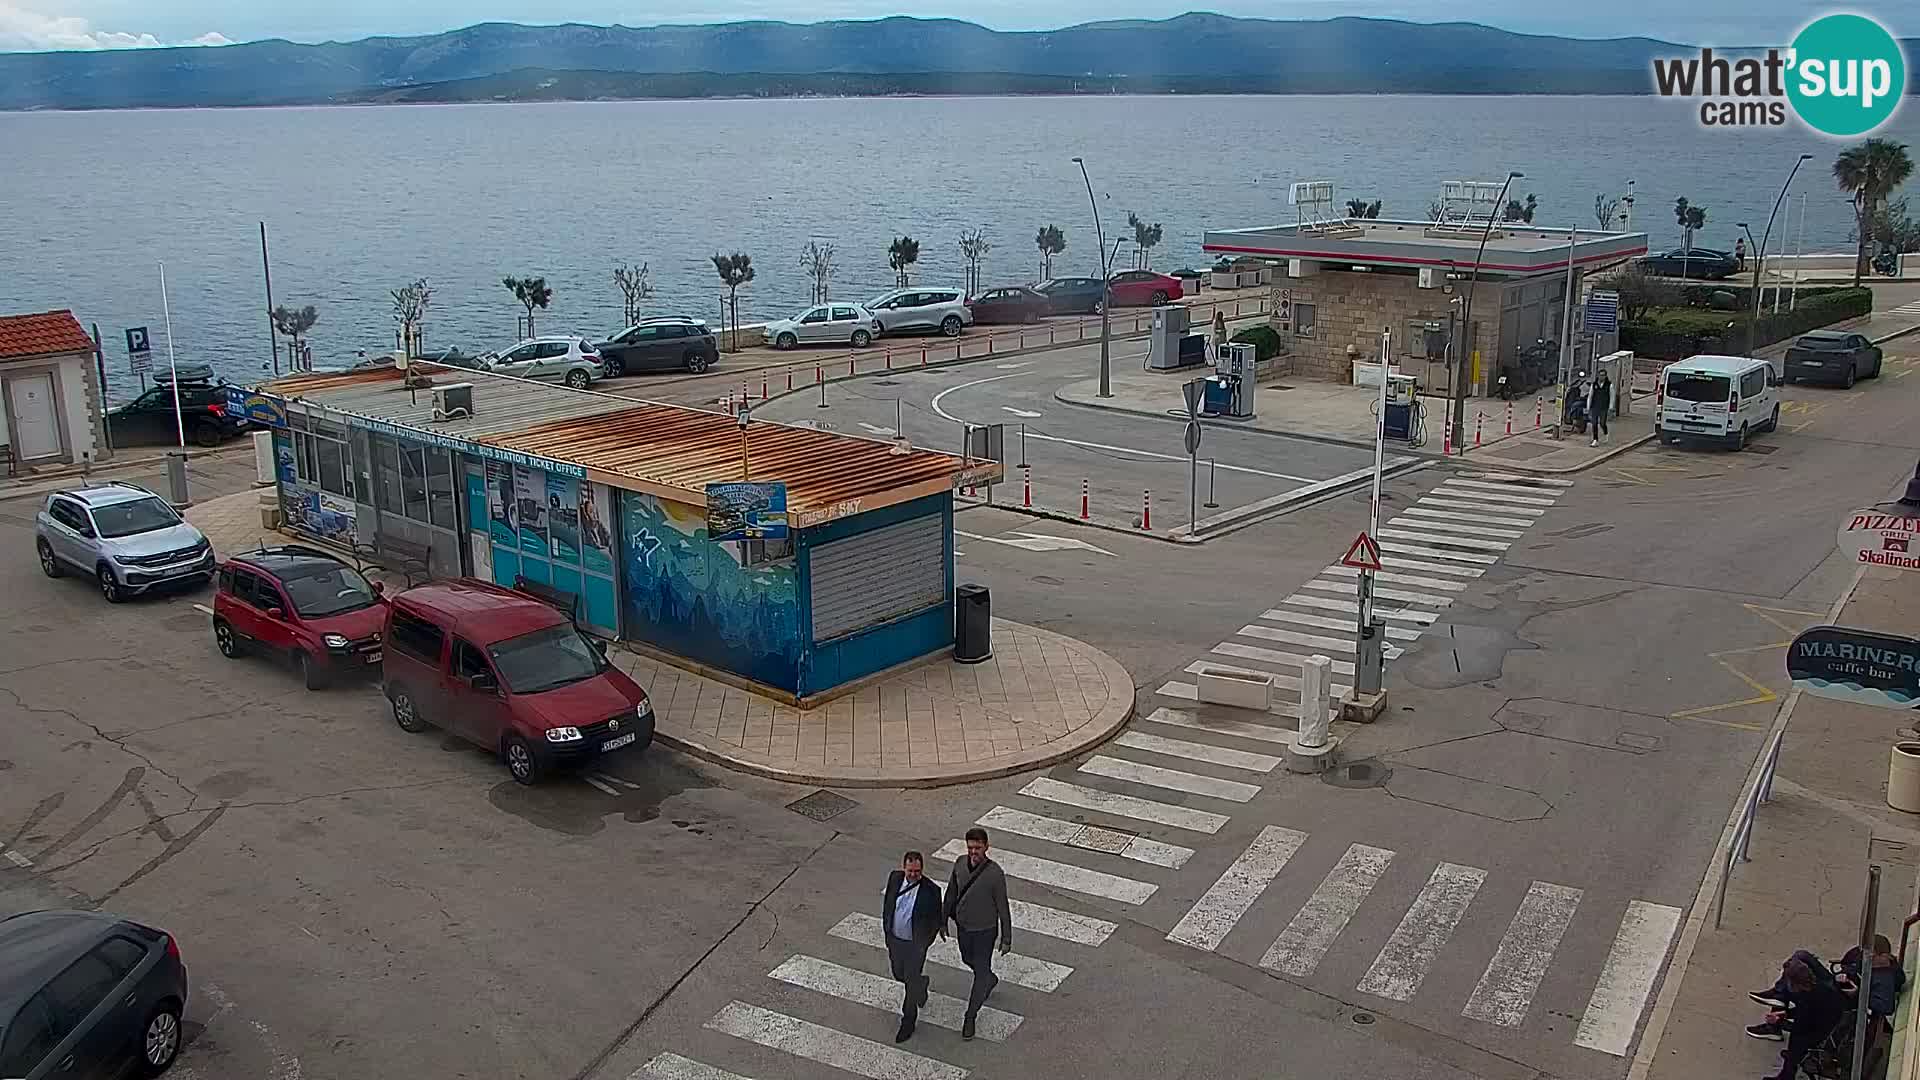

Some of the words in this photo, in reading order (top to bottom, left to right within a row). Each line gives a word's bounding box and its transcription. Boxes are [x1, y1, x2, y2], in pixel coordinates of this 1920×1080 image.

[479, 446, 494, 458] BUS
[495, 449, 527, 465] STATION
[528, 456, 555, 471] TICKET
[555, 462, 583, 477] OFFICE
[1847, 515, 1920, 534] PIZZE
[1880, 530, 1915, 541] GRILL
[1828, 661, 1865, 674] caffe
[1869, 665, 1896, 680] bar
